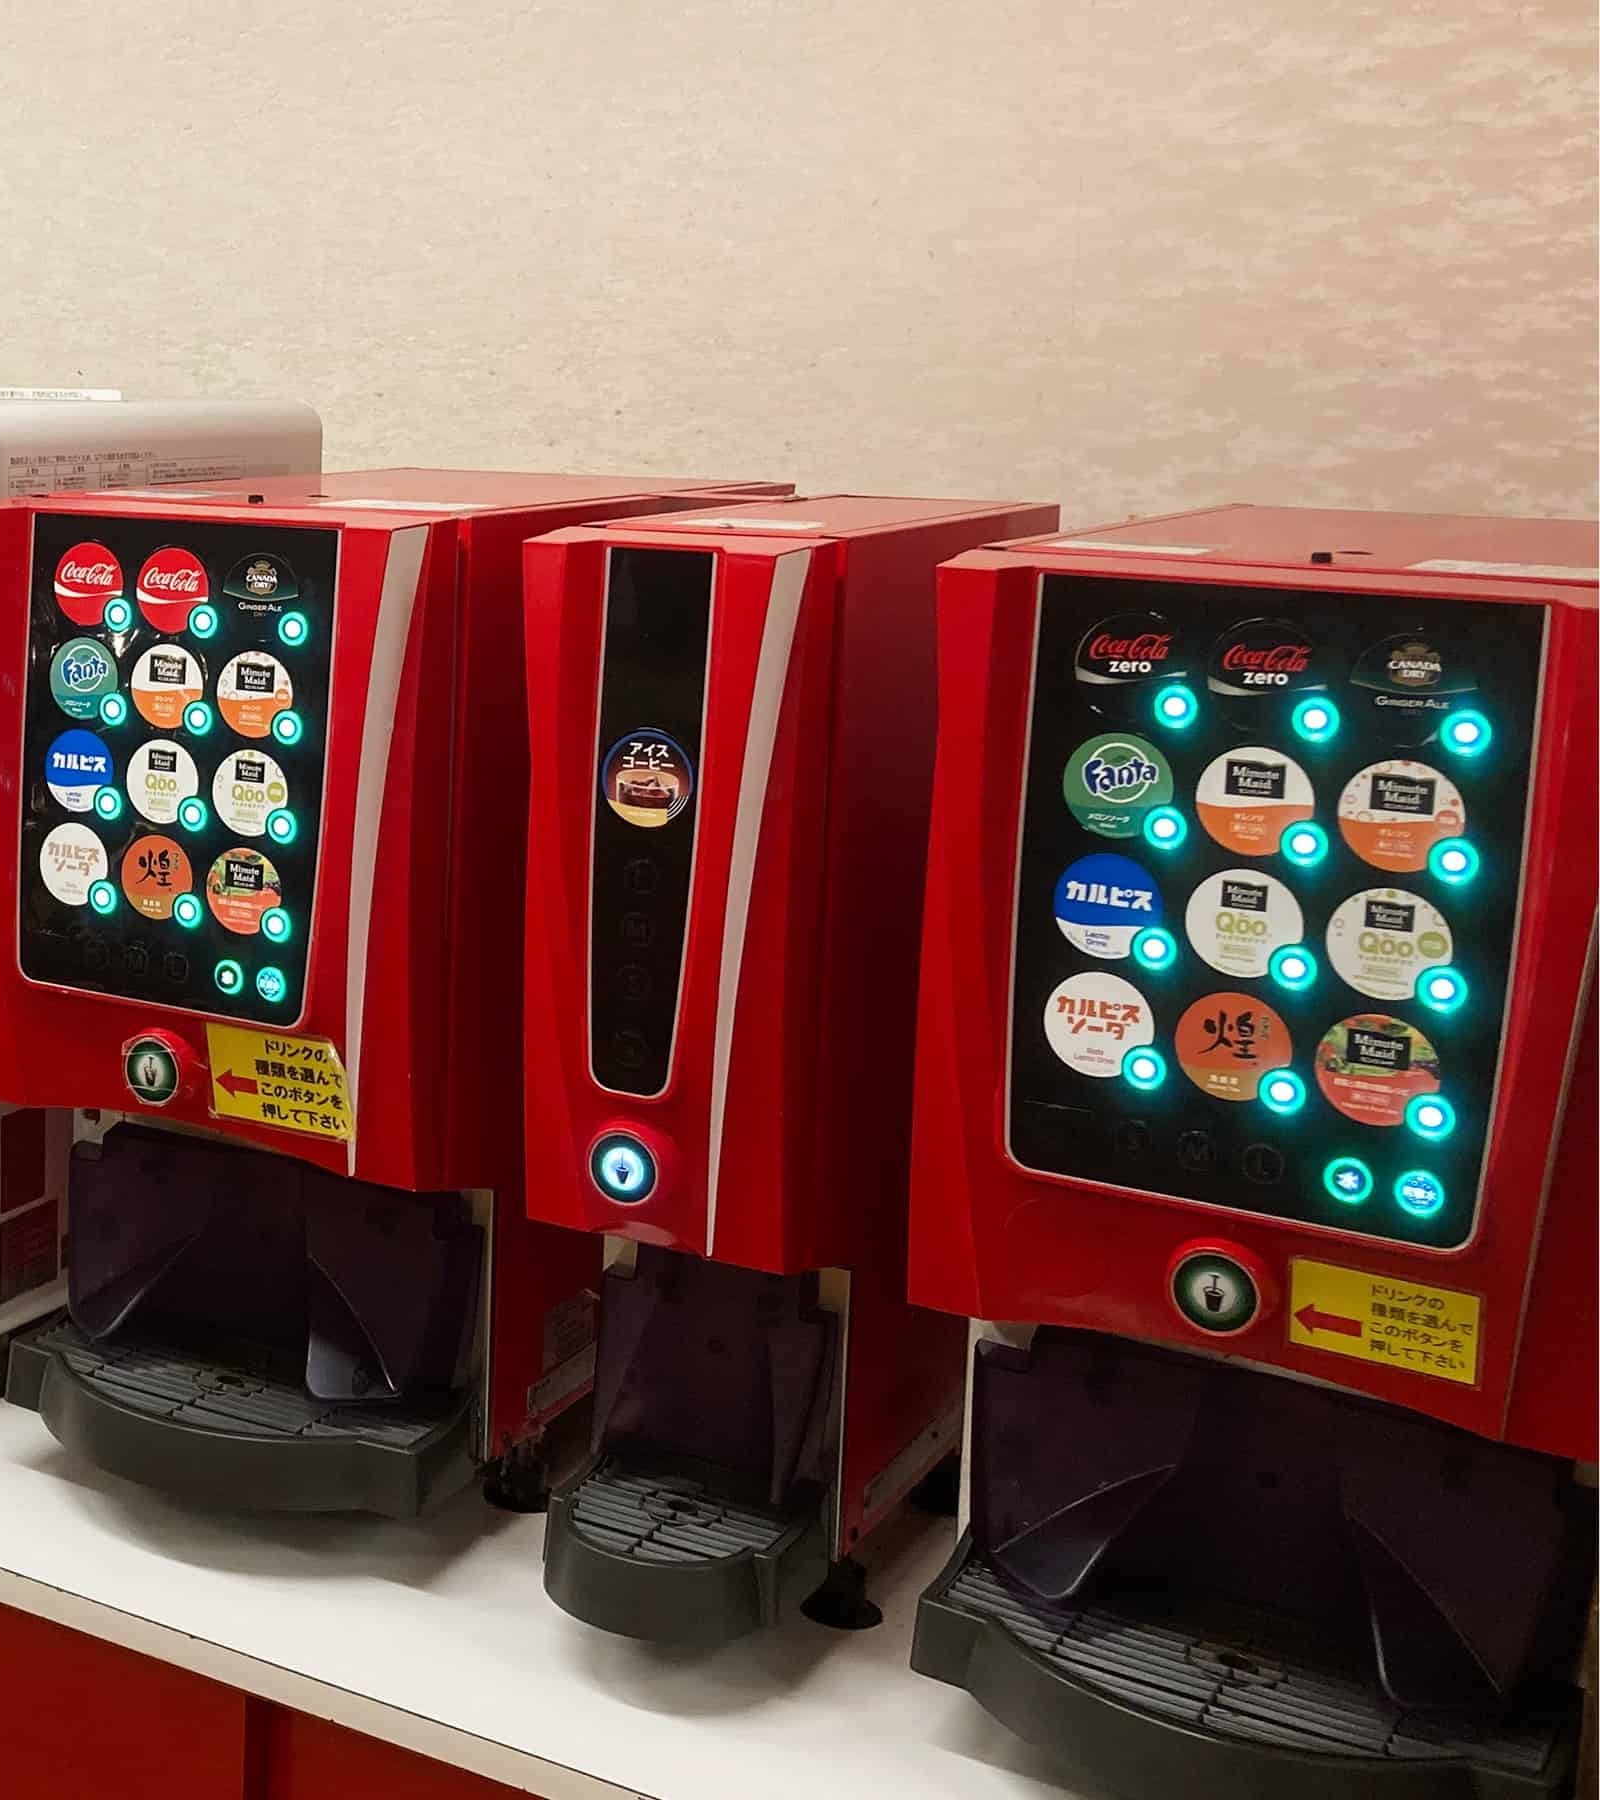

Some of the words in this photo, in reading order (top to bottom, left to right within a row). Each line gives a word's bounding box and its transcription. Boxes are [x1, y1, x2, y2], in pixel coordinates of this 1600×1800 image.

[61, 561, 118, 586] Coca-Cola
[143, 567, 202, 592] Coca-Cola
[246, 574, 278, 584] CANADA
[1088, 632, 1174, 661] Coca-Cola
[1109, 659, 1152, 674] zero
[1223, 643, 1312, 673] Coca-Cola
[1387, 658, 1441, 674] CANADA
[61, 658, 108, 686] Fanta
[240, 667, 271, 679] Minute
[244, 675, 267, 686] Maid
[1243, 670, 1289, 686] zero
[629, 742, 669, 758] アイス
[53, 753, 107, 773] カルピス
[622, 756, 675, 770] コーヒー
[1232, 764, 1280, 781] Minute
[145, 773, 177, 792] Qoo
[1083, 759, 1160, 795] Fanta
[1237, 777, 1273, 791] Maid
[1379, 779, 1429, 796] Minute
[232, 784, 265, 803] Qoo
[1383, 792, 1421, 806] Maid
[48, 841, 100, 861] カルピス
[54, 858, 91, 877] ソーダ
[136, 849, 174, 887] 煌
[229, 863, 260, 876] Minute
[233, 872, 257, 883] Maid
[1065, 880, 1153, 911] カルピス
[1215, 910, 1267, 937] Qoo
[1359, 931, 1414, 958] Qoo
[1056, 994, 1142, 1024] カルピス
[1067, 1015, 1131, 1042] ソーダ
[1197, 1009, 1258, 1061] 煌
[264, 1039, 328, 1063] ドリンクの
[1353, 1033, 1405, 1053] Minute
[1358, 1045, 1396, 1060] Maid
[255, 1058, 342, 1089] 種類を選んで
[261, 1082, 343, 1111] このボタンを
[262, 1102, 347, 1131] 押して下さい
[1371, 1283, 1445, 1311] ドリンクの
[1371, 1302, 1473, 1337] 種類を選んで
[1370, 1321, 1465, 1354] このボタンを
[1369, 1339, 1466, 1369] 押して下さい
